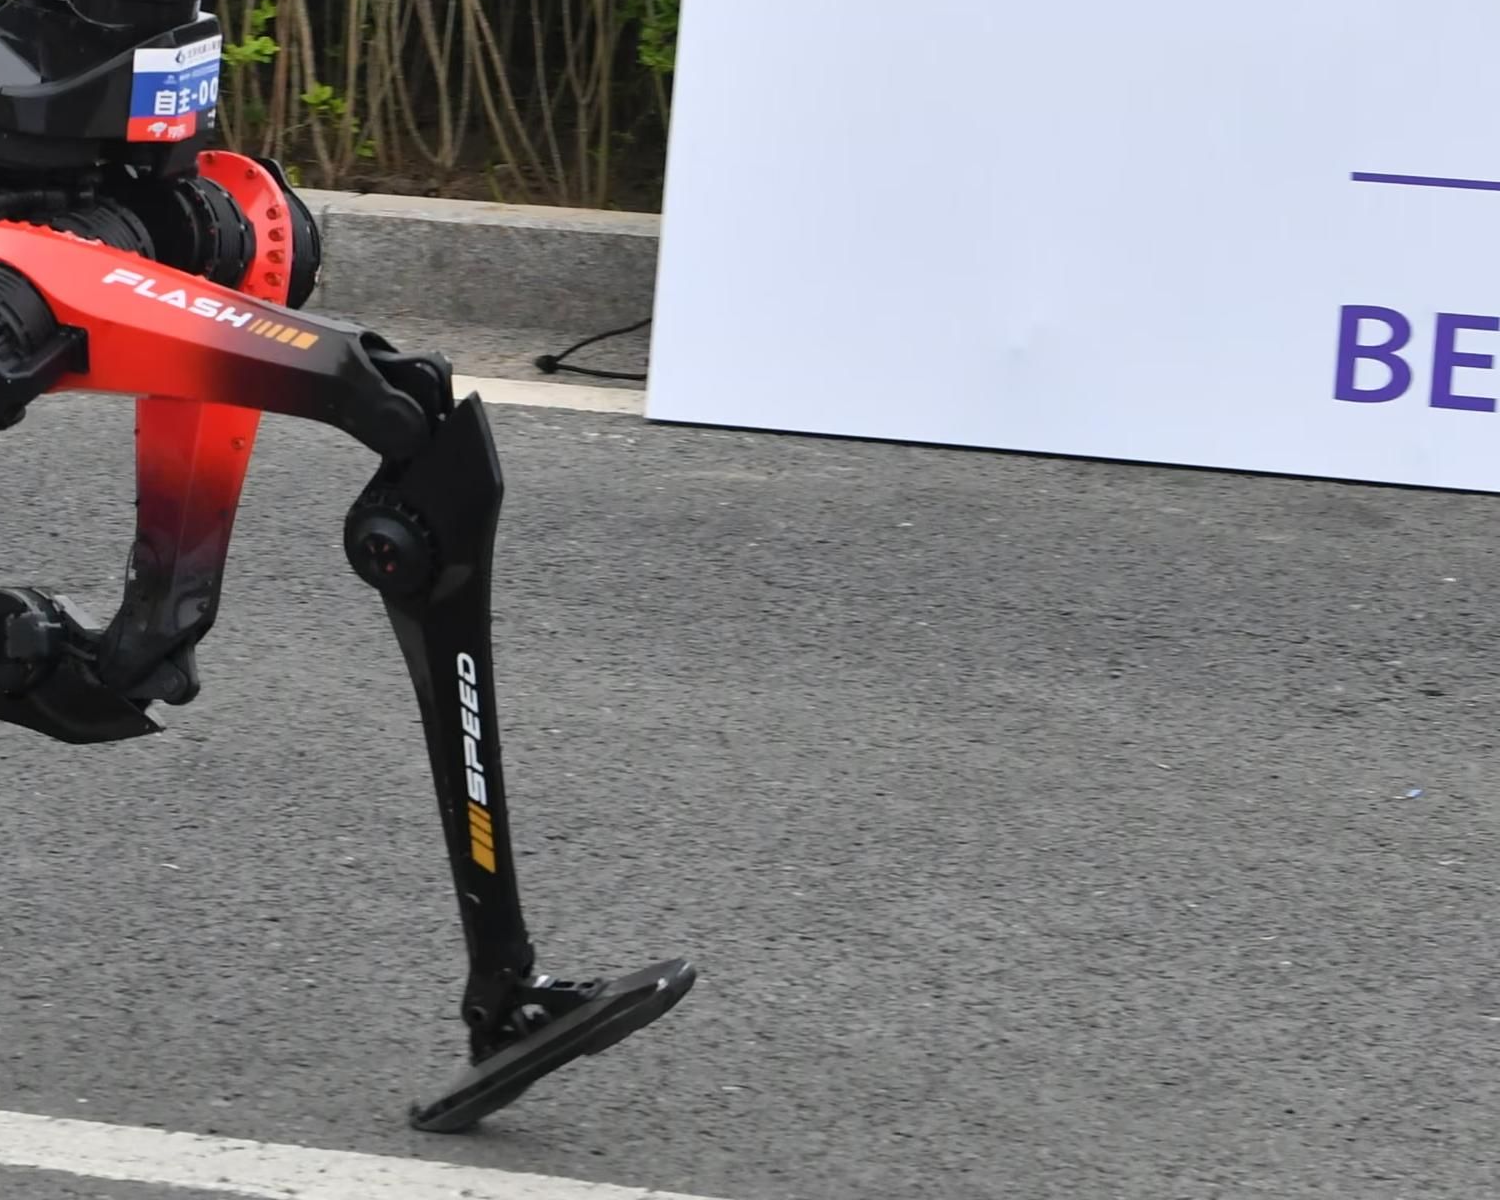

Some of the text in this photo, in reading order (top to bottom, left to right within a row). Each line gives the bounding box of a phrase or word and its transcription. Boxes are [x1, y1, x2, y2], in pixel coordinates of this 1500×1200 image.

[101, 267, 253, 329] FLASH
[1333, 304, 1500, 413] BE
[457, 652, 487, 806] SPEED
